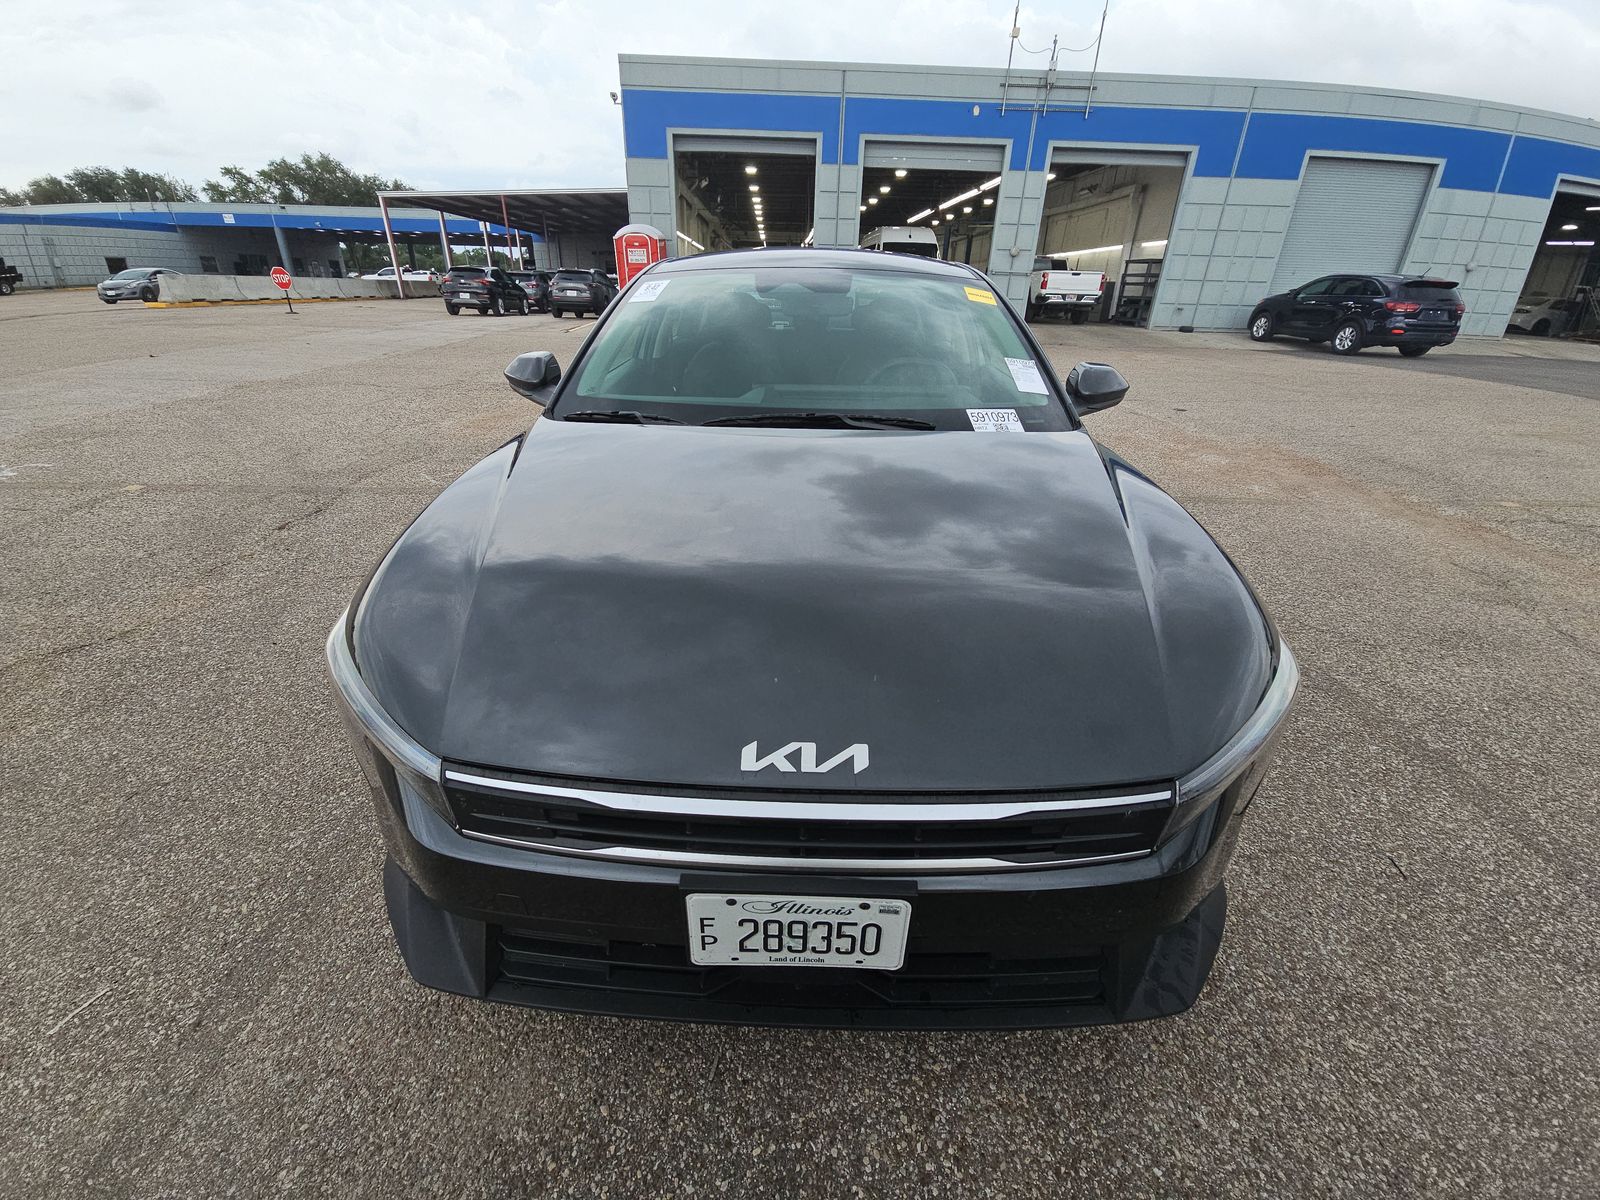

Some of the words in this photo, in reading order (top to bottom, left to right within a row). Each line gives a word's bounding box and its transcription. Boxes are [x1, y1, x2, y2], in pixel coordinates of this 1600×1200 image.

[272, 274, 290, 283] STOP
[971, 411, 1019, 422] 5910973
[740, 740, 869, 774] KIA
[741, 900, 855, 916] Illinois
[738, 918, 882, 955] 289350
